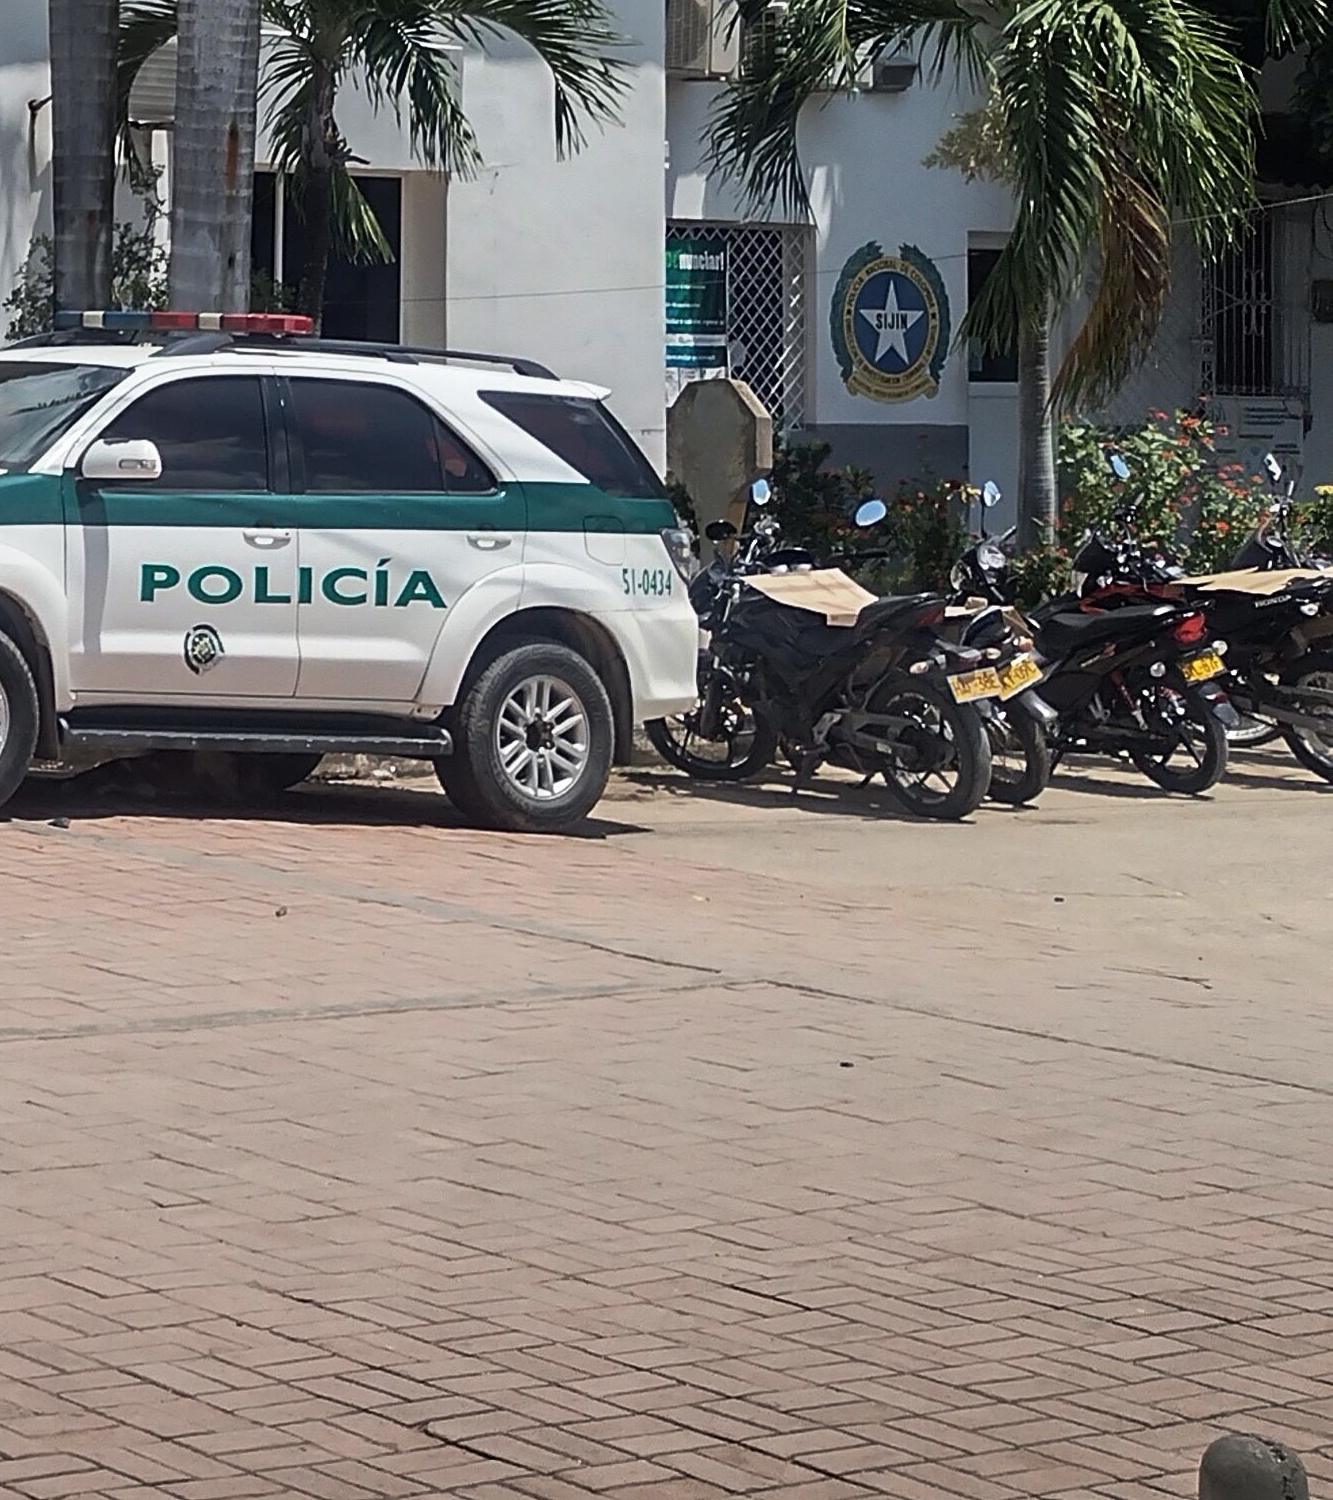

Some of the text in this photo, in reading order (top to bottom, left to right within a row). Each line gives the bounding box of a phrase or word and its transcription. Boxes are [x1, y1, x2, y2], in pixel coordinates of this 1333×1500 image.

[875, 313, 908, 330] SIJIN
[140, 557, 448, 609] POLICÍA
[622, 568, 672, 596] 51-0434
